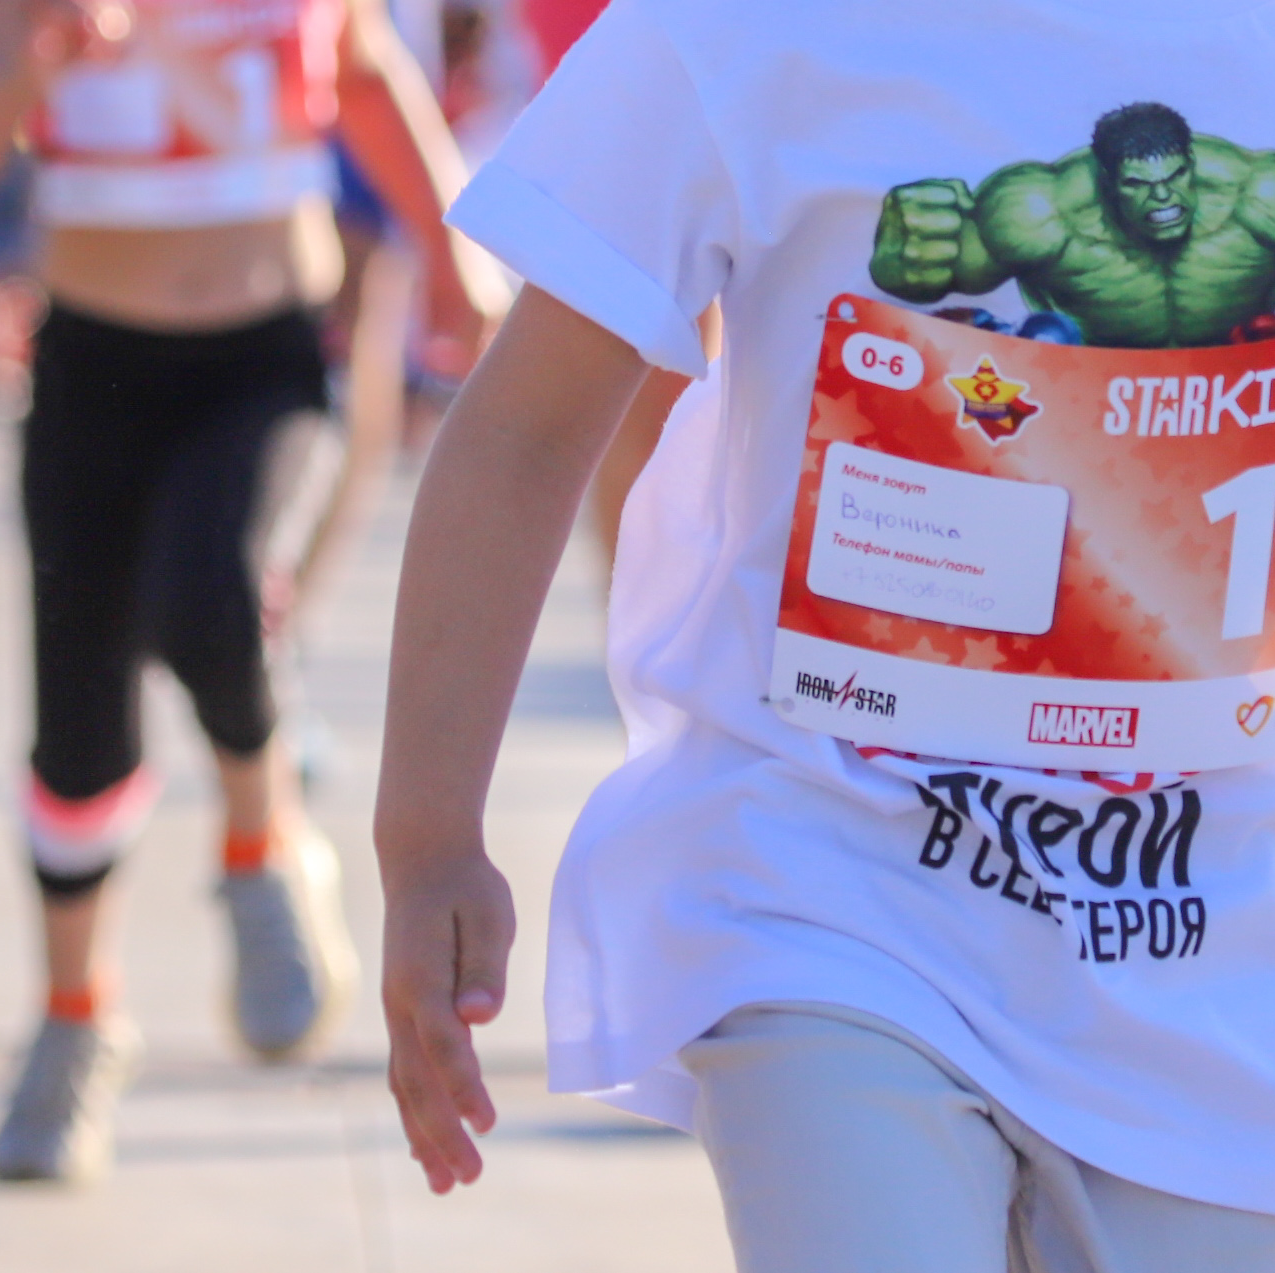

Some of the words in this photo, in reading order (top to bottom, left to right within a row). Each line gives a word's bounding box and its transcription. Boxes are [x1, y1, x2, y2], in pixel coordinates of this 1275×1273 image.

[860, 347, 905, 377] 0-6
[841, 463, 880, 484] Меня
[882, 477, 927, 495] зовут
[841, 492, 962, 540] Вероника
[832, 531, 891, 556] Телефон
[892, 549, 986, 576] мамы/папы
[1031, 707, 1137, 747] MARVEL
